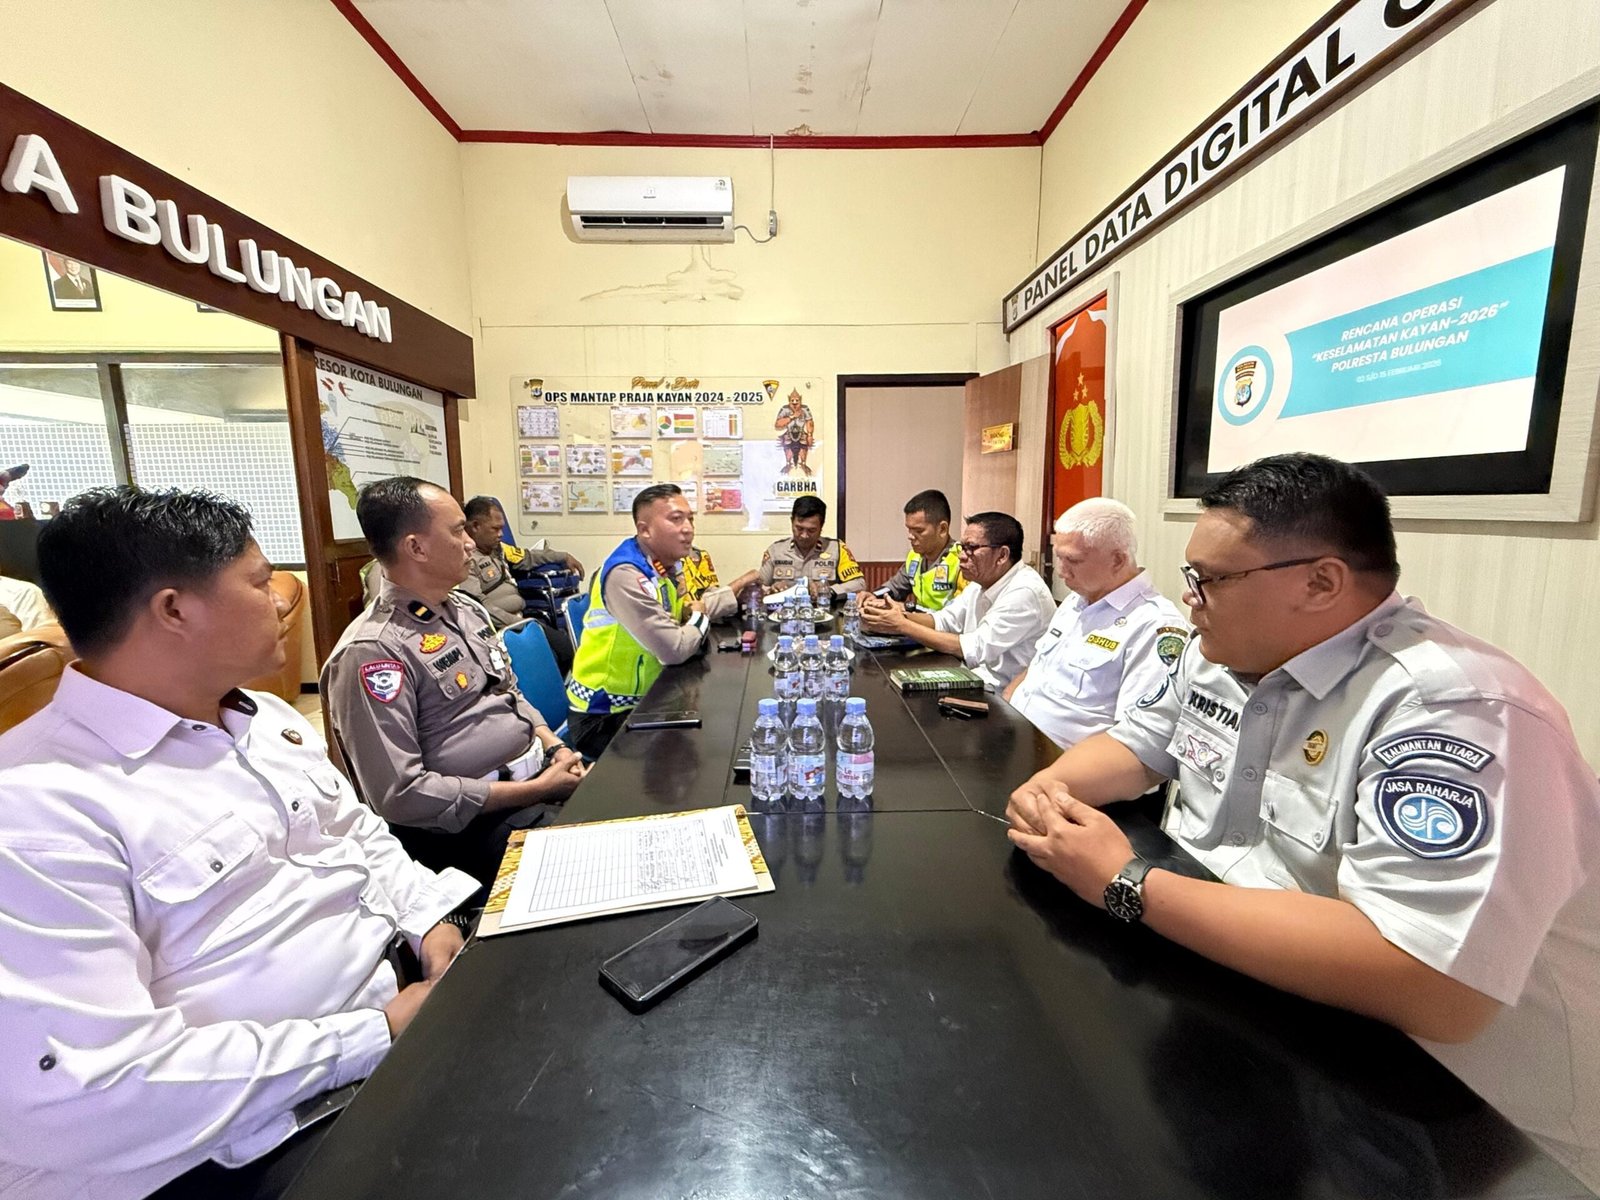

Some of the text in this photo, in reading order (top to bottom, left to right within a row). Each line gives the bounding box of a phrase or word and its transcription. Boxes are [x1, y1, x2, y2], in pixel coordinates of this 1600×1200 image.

[1023, 27, 1356, 311] PANEL DATA DIGITAL
[2, 133, 392, 343] A BULUNGAN
[1341, 296, 1463, 342] RENCANA OPERASI
[1331, 330, 1470, 373] POLRESTA BULUNGAN
[350, 367, 376, 387] KOTA
[378, 377, 423, 401] BULUNGAN
[545, 392, 568, 402] OPS
[571, 392, 617, 403] MANTAP
[620, 392, 655, 403] PRAJA
[656, 392, 692, 403] KAYAN
[695, 392, 724, 403] 2024
[734, 392, 763, 403] 2025
[777, 481, 817, 492] GARBHA
[1188, 690, 1240, 732] KRISTIA
[1383, 740, 1480, 763] KALIMANTAN UTARA
[1385, 781, 1474, 809] JASA RAHARJA
